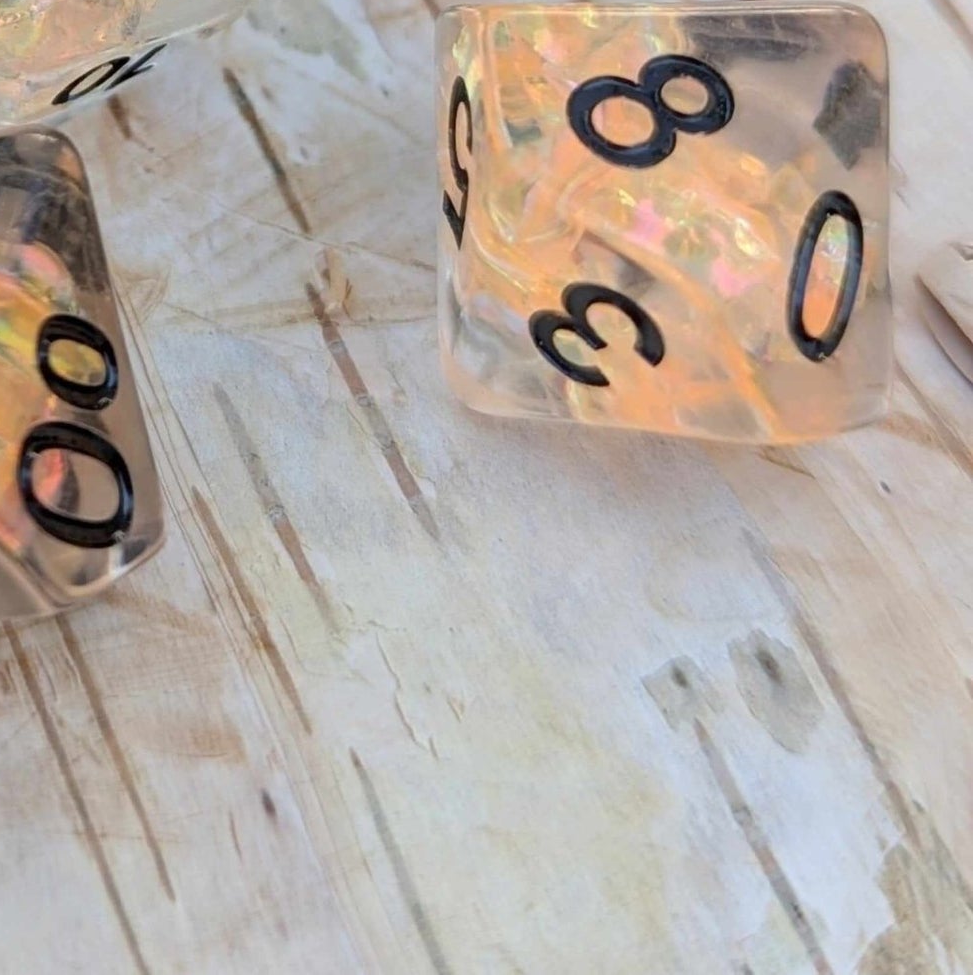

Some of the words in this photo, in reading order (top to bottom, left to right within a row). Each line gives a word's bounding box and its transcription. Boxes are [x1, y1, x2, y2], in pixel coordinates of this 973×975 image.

[442, 76, 473, 250] 5
[566, 54, 735, 169] 8
[529, 282, 665, 387] 3
[787, 190, 864, 363] 0
